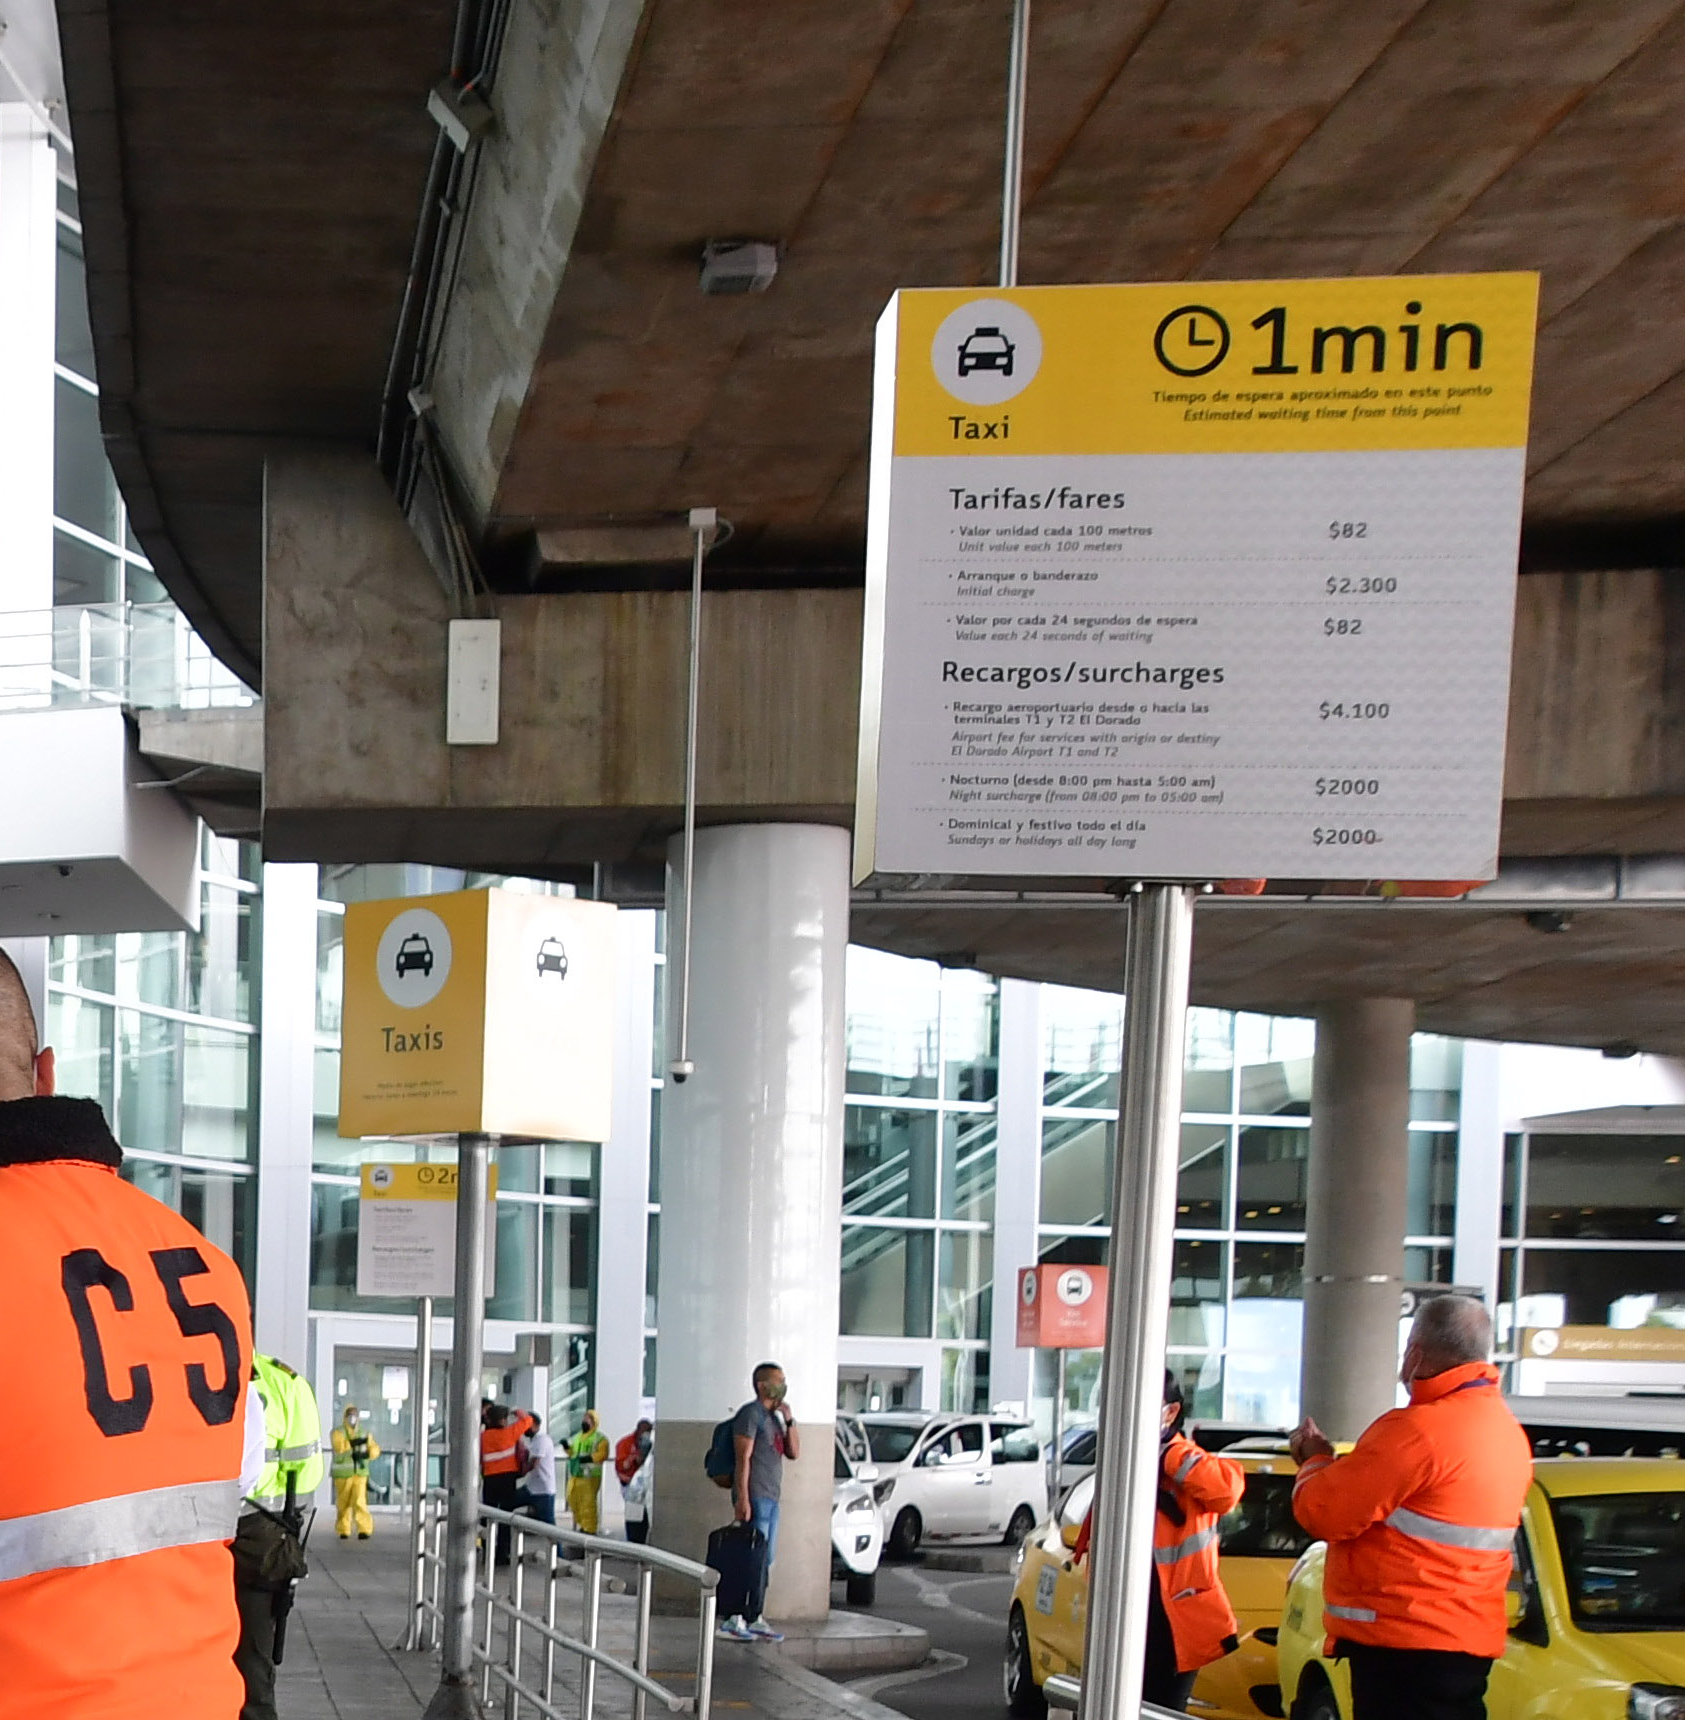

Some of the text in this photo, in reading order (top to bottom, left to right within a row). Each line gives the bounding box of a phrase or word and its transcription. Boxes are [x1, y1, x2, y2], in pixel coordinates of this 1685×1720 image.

[1251, 301, 1484, 375] 1min
[1153, 384, 1493, 404] Tiempo de espera aproximado en este punto
[1183, 404, 1461, 422] Estimated waiting time from this point
[948, 415, 1009, 439] Taxi
[949, 487, 1125, 510] Tarifas/fares
[959, 525, 1153, 536] Valor unidad cada 100 metros
[1328, 521, 1368, 540] $82
[959, 541, 1123, 552] Unit value each 100 meters
[957, 570, 1099, 583] Arranque o banderazo
[957, 586, 1036, 599] Initial charge
[1325, 575, 1397, 595] $2.300
[956, 615, 1198, 628] Valor por cada 24 segundos de espera
[1324, 617, 1363, 637] $82
[956, 630, 1154, 644] Value each 24 seconds of waiting
[942, 661, 1224, 689] Recargos/surcharges
[953, 702, 1209, 715] Recargo aeroportuario desde o hacia las
[1319, 700, 1390, 720] $4.100
[954, 714, 1141, 728] terminales T1 y T2 El Dorado
[952, 732, 993, 745] Airport
[997, 731, 1015, 744] fee
[1018, 732, 1036, 744] for
[1040, 733, 1085, 743] services
[1090, 733, 1117, 743] with
[1121, 733, 1157, 745] origin
[1177, 733, 1221, 747] destiny
[966, 746, 1008, 757] Dorado
[1012, 746, 1054, 759] Airport
[1058, 746, 1073, 757] T1
[1077, 746, 1101, 757] and
[1105, 747, 1119, 757] T2
[950, 774, 1216, 789] Nocturno (desde 8:00 pm hasta 5:00 am)
[1315, 777, 1380, 796] $2000
[949, 790, 981, 803] Night
[986, 791, 1041, 804] surcharge
[1045, 790, 1078, 805] (from
[1121, 793, 1140, 805] pm
[1144, 791, 1156, 802] to
[948, 818, 1146, 833] Dominical y festivo todo el día
[947, 835, 1137, 849] Sundays or holidays all day long
[1312, 828, 1377, 847] $2000
[381, 1024, 444, 1053] Taxis
